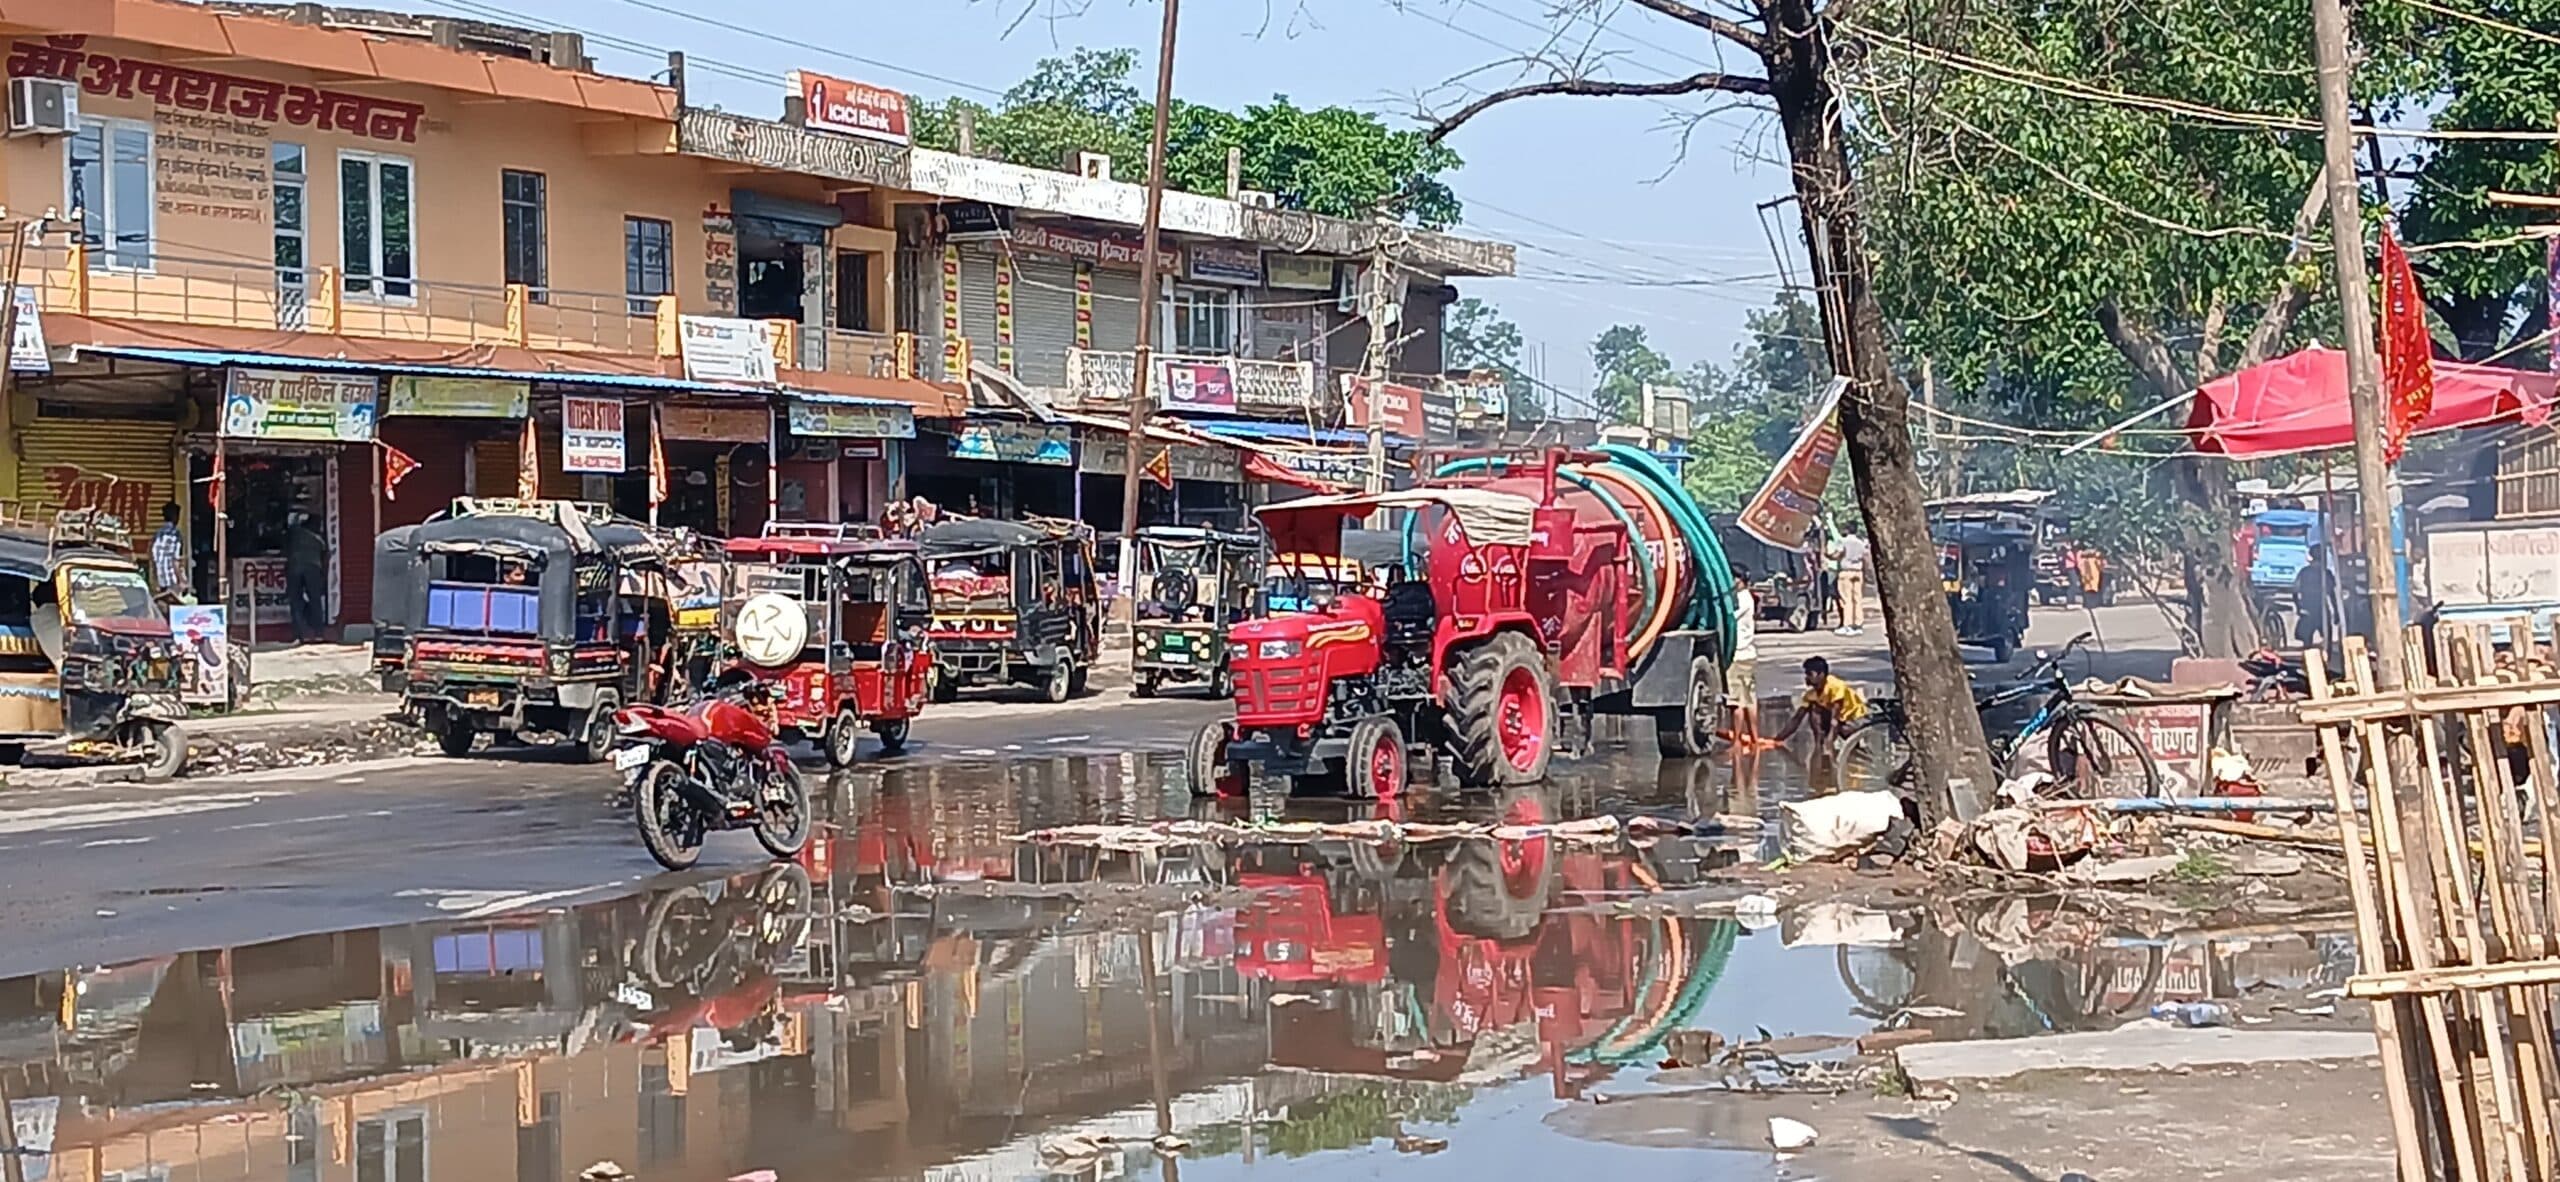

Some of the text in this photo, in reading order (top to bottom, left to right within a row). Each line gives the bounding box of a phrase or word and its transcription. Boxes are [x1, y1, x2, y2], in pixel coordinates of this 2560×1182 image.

[284, 85, 425, 143] भवन
[828, 103, 889, 131] ICICI Bank
[929, 618, 1008, 633] ATUL
